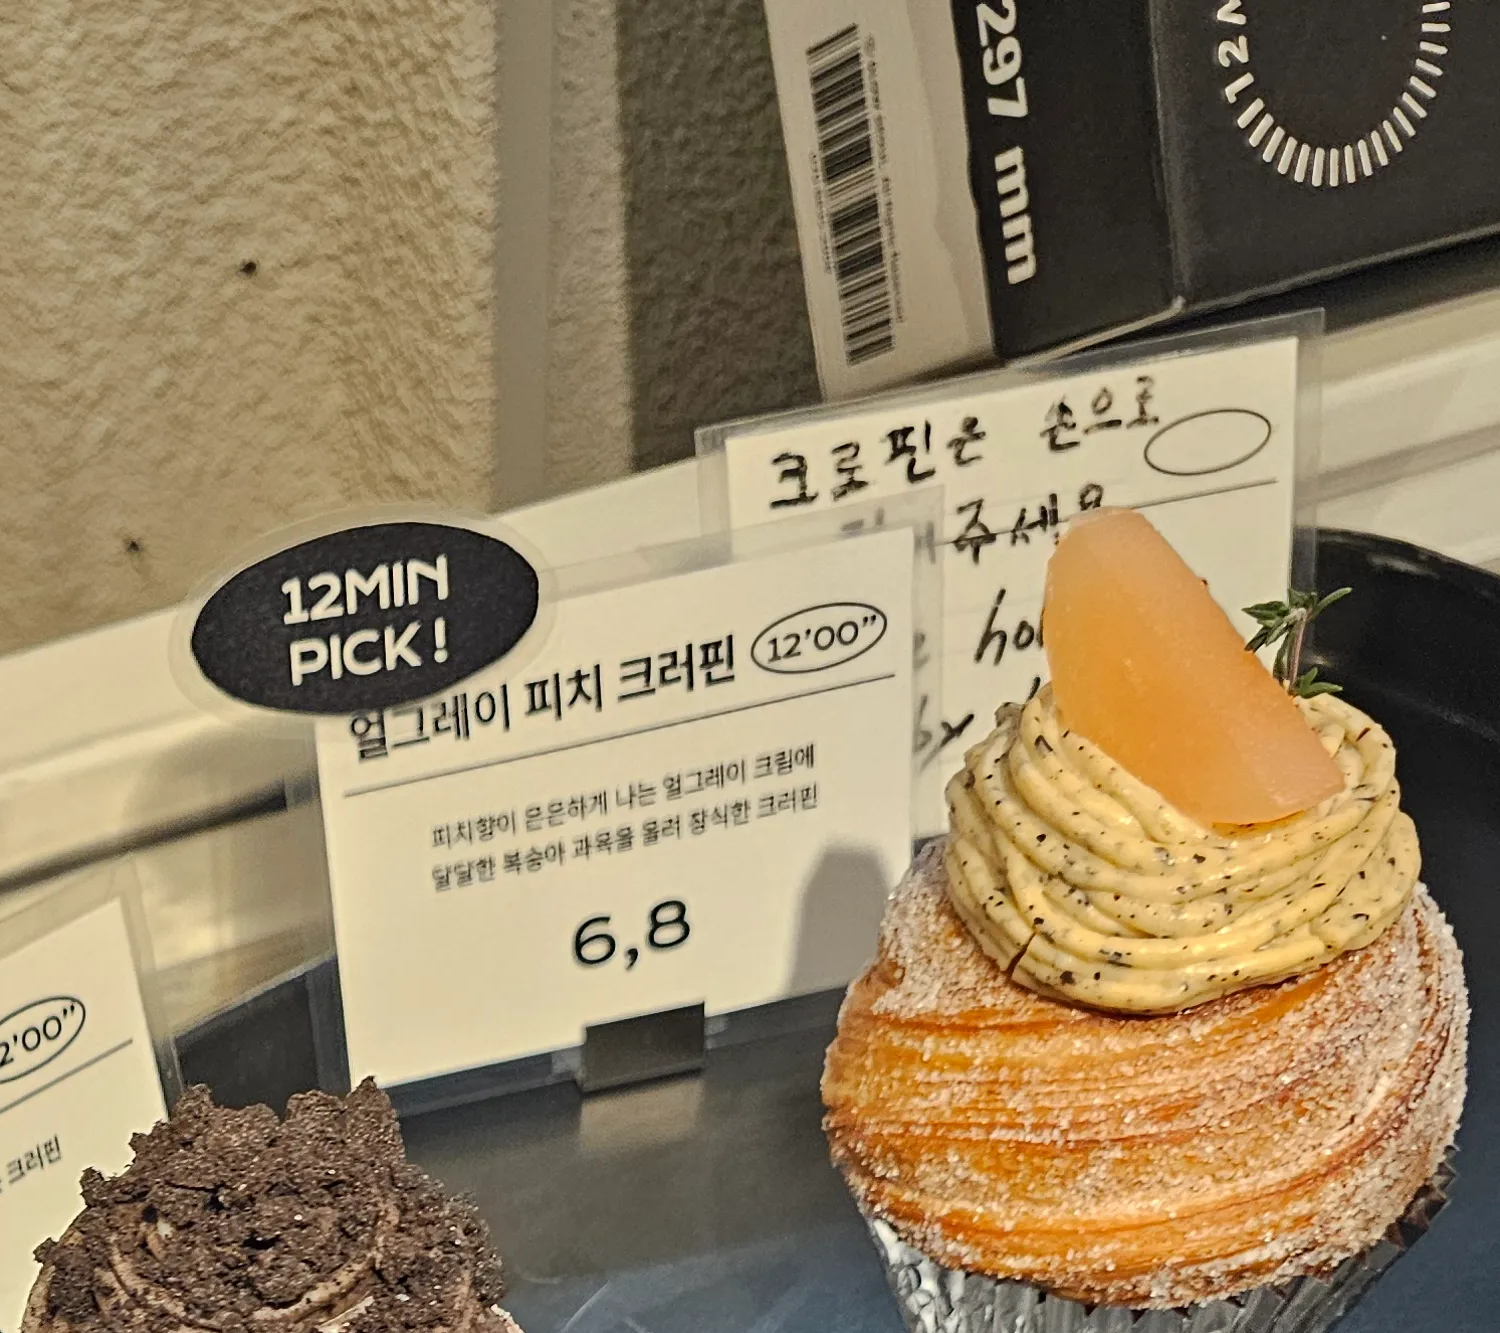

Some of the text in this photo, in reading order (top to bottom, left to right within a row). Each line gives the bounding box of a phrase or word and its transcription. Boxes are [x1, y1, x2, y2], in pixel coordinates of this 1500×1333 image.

[976, 0, 1037, 285] 297 mm
[280, 553, 450, 626] 12MIN
[348, 682, 511, 764] 얼그레이
[524, 663, 604, 721] 피치
[617, 634, 736, 702] 크러핀
[431, 742, 816, 850] 피치향이 은은하게 나는 얼그레이 크림에
[431, 854, 497, 894] 달달한
[501, 839, 567, 877] 복숭아
[687, 798, 752, 837] 장식한
[755, 783, 820, 820] 크러핀
[572, 899, 692, 972] 6,8
[5, 1132, 63, 1186] 크러핀
